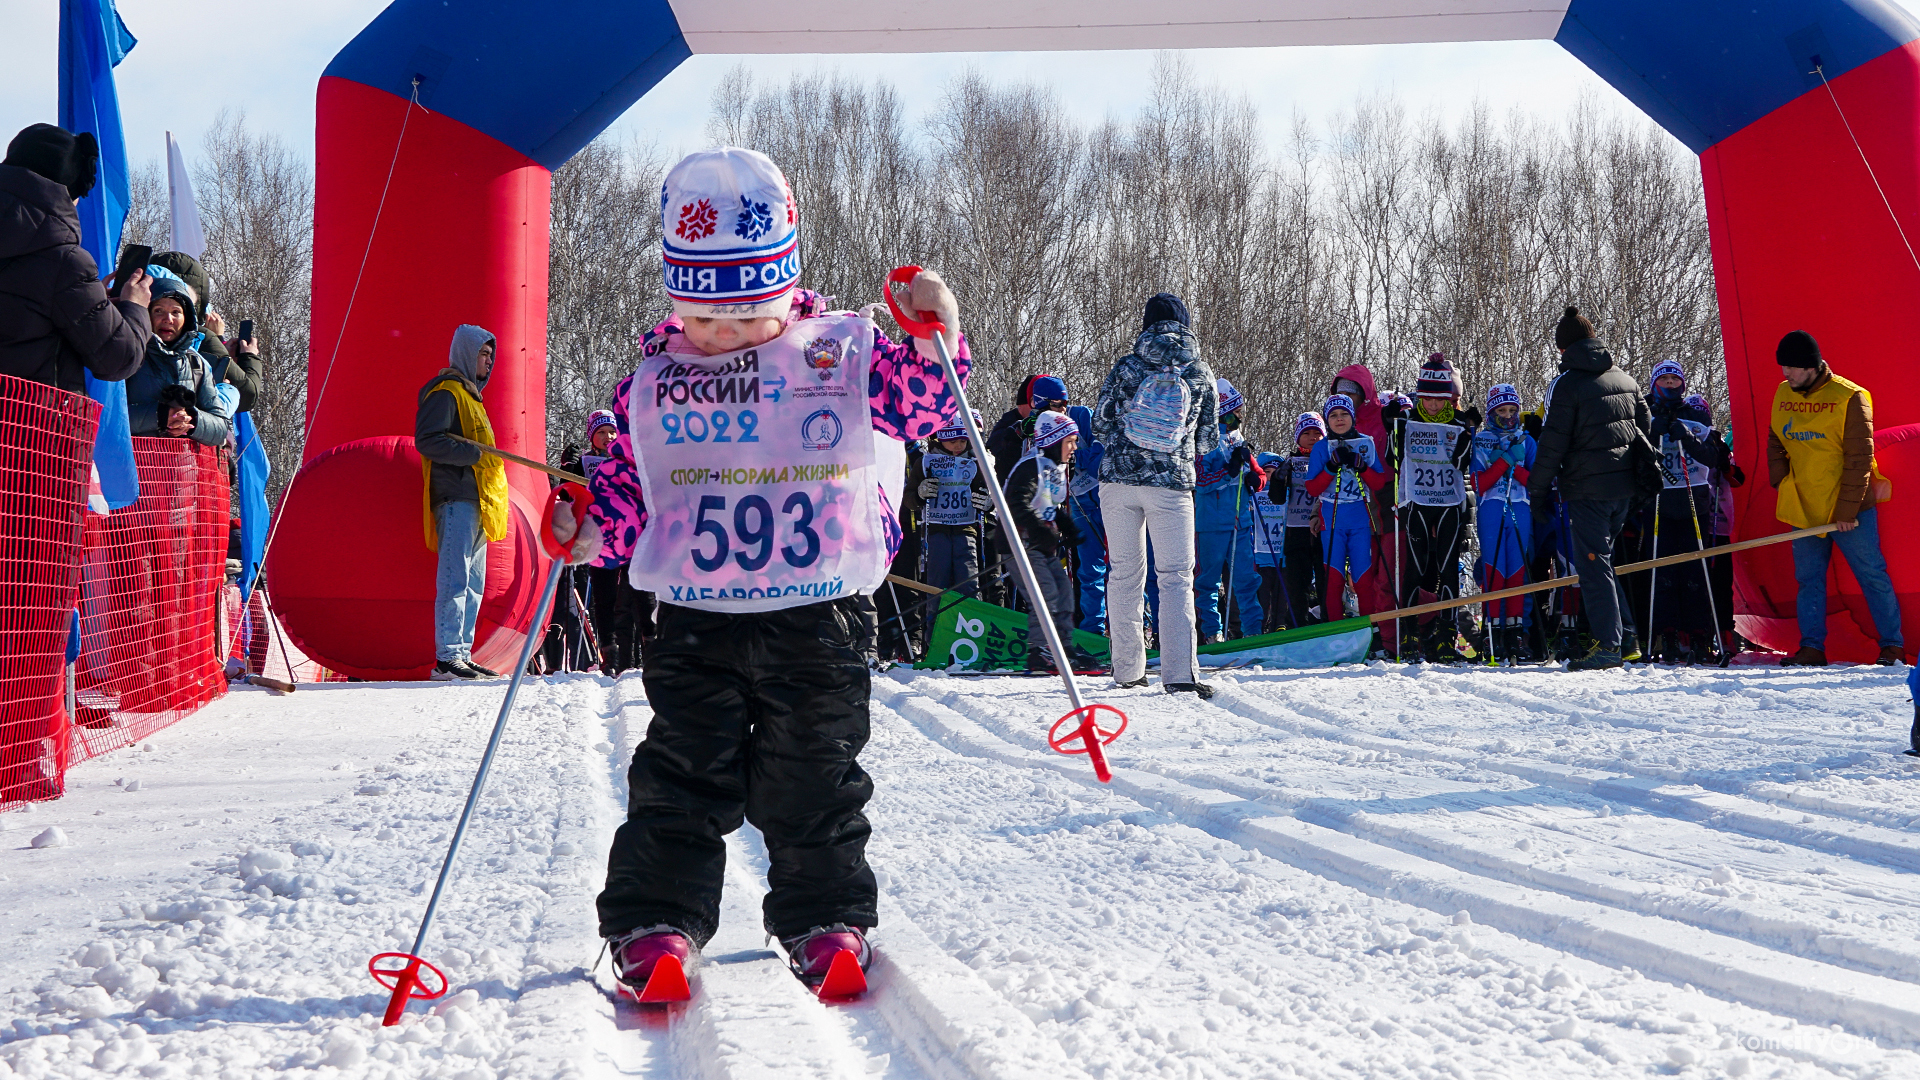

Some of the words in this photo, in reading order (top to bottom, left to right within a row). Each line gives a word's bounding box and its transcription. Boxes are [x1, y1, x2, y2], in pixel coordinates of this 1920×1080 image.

[1422, 370, 1447, 380] FILA
[656, 376, 760, 407] РОССИИ
[1778, 401, 1837, 413] РОССПОРТ
[661, 409, 760, 446] 2022
[1409, 431, 1438, 439] ЛЫЖНЯ
[1410, 438, 1438, 446] РОССИИ
[1410, 445, 1438, 455] 2022
[670, 467, 711, 487] СПОРТ
[720, 466, 790, 486] НОРМА
[791, 463, 850, 483] ЖИЗНИ
[1414, 467, 1455, 488] 2313
[690, 491, 821, 572] 593
[668, 575, 844, 602] ХАБАРОВСКИЙ
